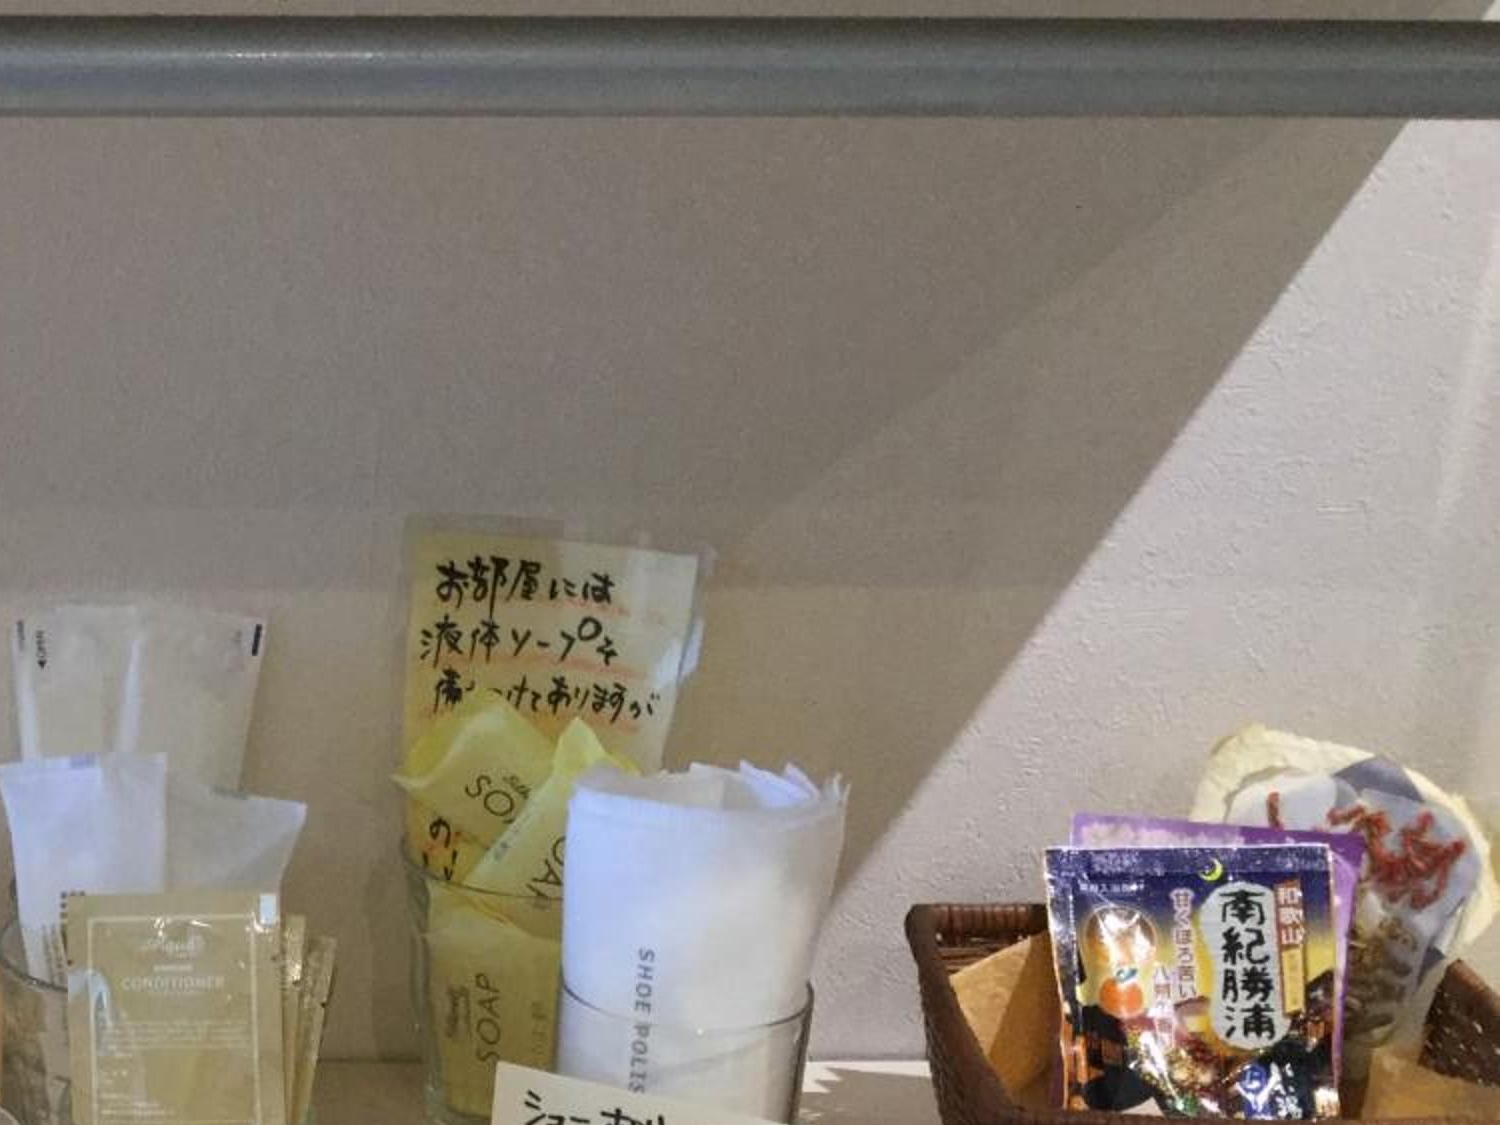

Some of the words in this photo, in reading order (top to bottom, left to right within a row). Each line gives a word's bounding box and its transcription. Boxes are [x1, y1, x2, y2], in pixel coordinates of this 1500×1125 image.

[435, 556, 614, 616] お部屋には
[420, 614, 618, 668] 液体ソープを
[636, 948, 656, 1015] SHOE
[1219, 888, 1277, 1041] 南紀勝浦
[474, 972, 501, 1063] SOAP
[627, 1021, 651, 1095] POLIS
